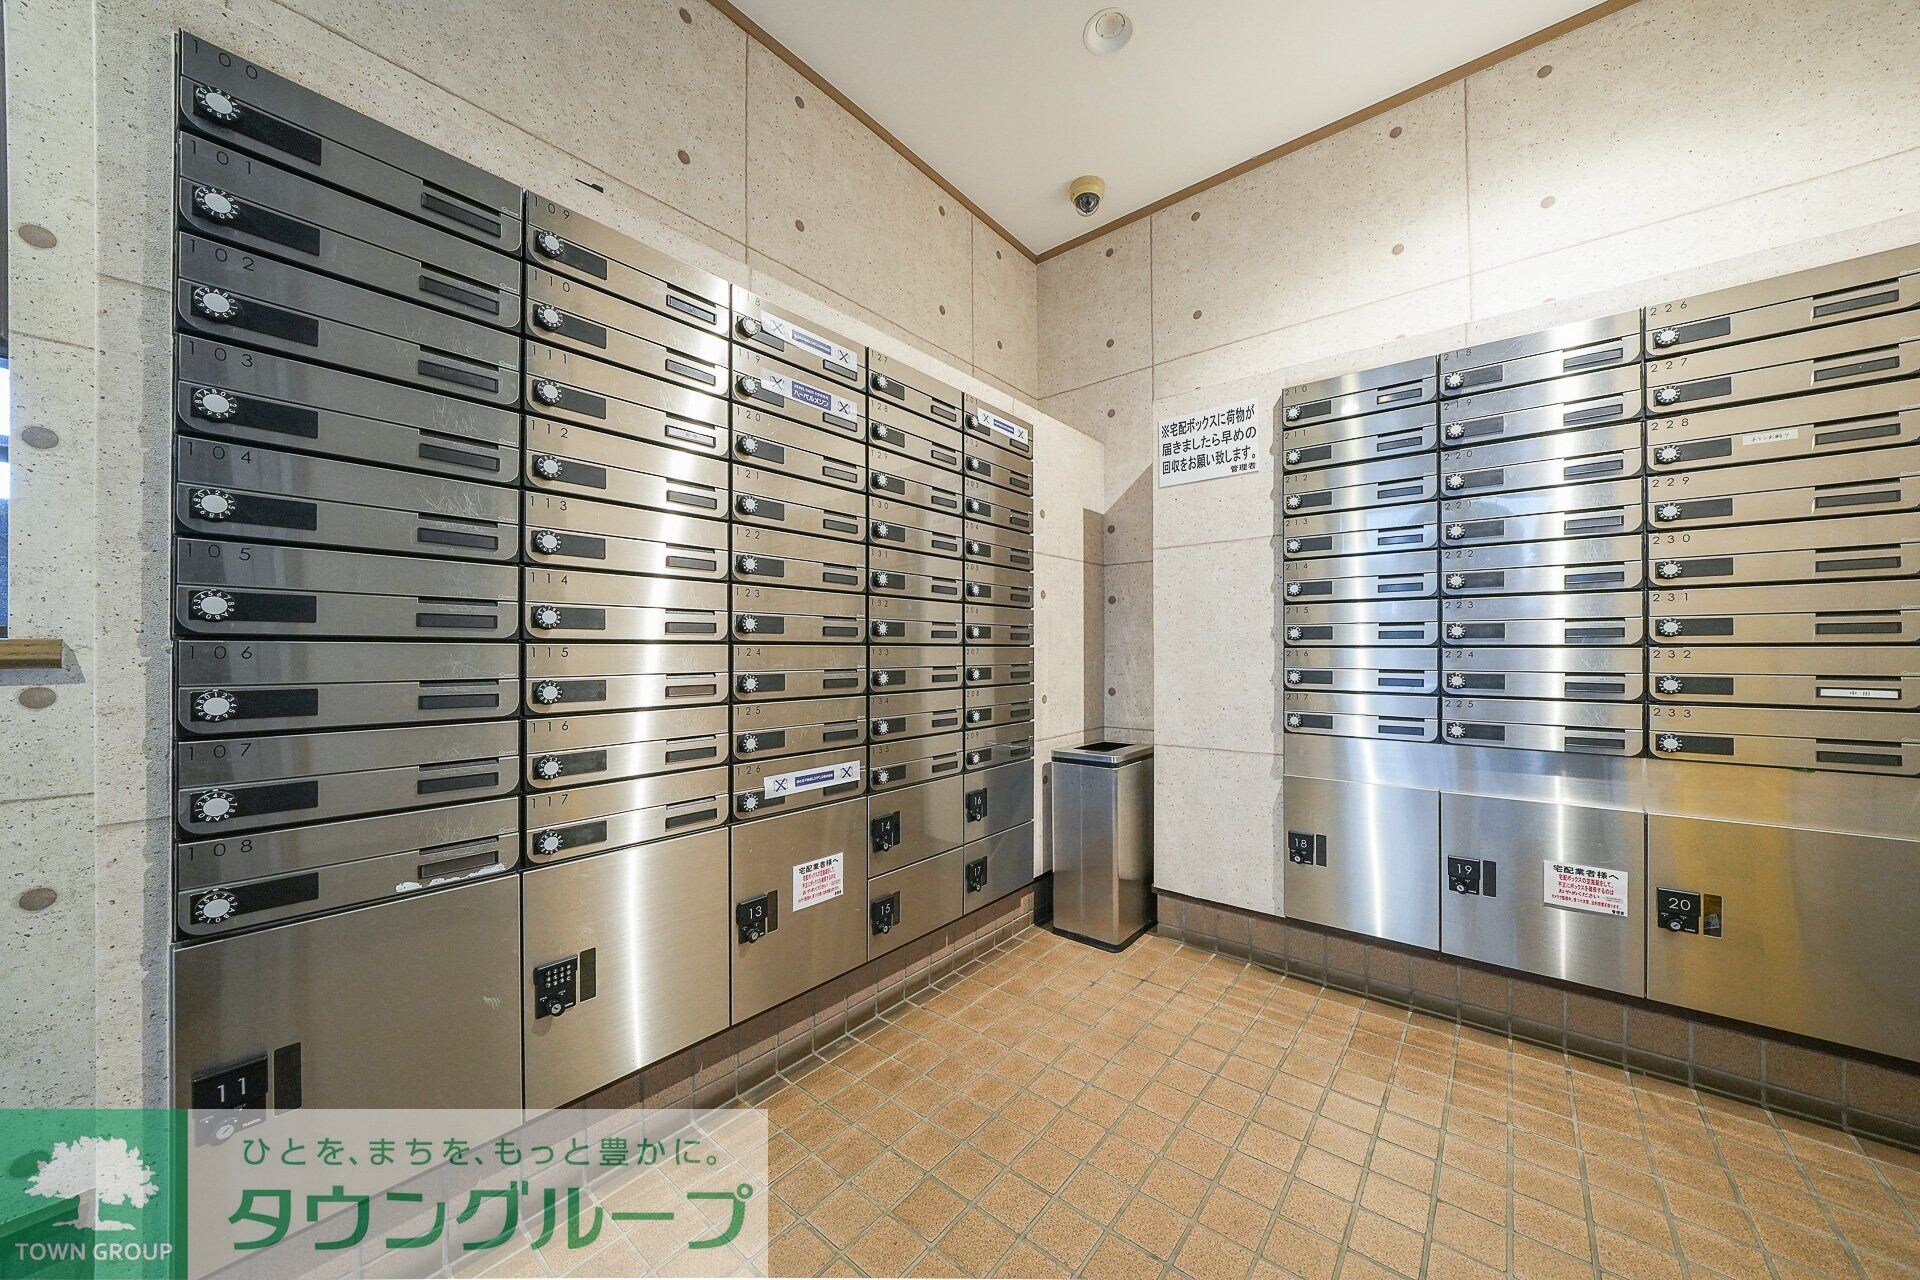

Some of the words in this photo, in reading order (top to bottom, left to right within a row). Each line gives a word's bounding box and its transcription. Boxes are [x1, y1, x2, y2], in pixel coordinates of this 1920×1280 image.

[192, 38, 258, 80] 100
[190, 139, 252, 176] 101
[533, 195, 570, 220] 109
[189, 238, 256, 272] 102
[533, 269, 571, 293] 110
[1650, 301, 1687, 316] 226
[189, 340, 254, 369] 103
[532, 345, 568, 365] 111
[738, 348, 760, 363] 119
[871, 350, 888, 363] 127
[1444, 349, 1472, 361] 218
[1650, 358, 1688, 373] 227
[1285, 386, 1308, 396] 210
[871, 399, 889, 413] 128
[1444, 399, 1472, 410] 219
[736, 407, 760, 422] 120
[531, 419, 568, 439] 112
[1651, 418, 1689, 431] 228
[1285, 429, 1306, 440] 211
[965, 435, 979, 448] 202
[1162, 426, 1257, 457] 届きましたら早めの
[186, 440, 253, 465] 104
[871, 449, 888, 461] 129
[1444, 450, 1473, 461] 220
[1162, 445, 1256, 475] 回収をお願い致します。
[736, 467, 759, 480] 121
[1231, 462, 1256, 473] 管理者
[1285, 475, 1308, 483] 212
[1652, 476, 1690, 488] 229
[530, 495, 568, 512] 113
[871, 499, 889, 510] 130
[1444, 500, 1472, 511] 221
[1285, 518, 1308, 527] 213
[736, 526, 760, 540] 122
[1653, 534, 1691, 545] 230
[185, 542, 252, 562] 105
[871, 548, 888, 559] 131
[1445, 550, 1474, 559] 222
[531, 571, 568, 585] 114
[735, 587, 760, 598] 123
[1653, 593, 1689, 602] 231
[871, 598, 889, 608] 132
[1445, 601, 1474, 609] 223
[188, 645, 253, 660] 106
[531, 646, 569, 658] 115
[737, 648, 761, 657] 124
[872, 648, 889, 656] 133
[966, 648, 979, 656] 207
[1653, 649, 1691, 659] 232
[966, 690, 980, 698] 208
[1286, 693, 1308, 701] 217
[872, 696, 889, 705] 134
[1446, 700, 1474, 708] 225
[736, 705, 761, 716] 125
[1653, 708, 1691, 718] 233
[532, 719, 569, 733] 116
[187, 742, 252, 761] 107
[872, 746, 890, 756] 135
[736, 764, 761, 776] 126
[531, 793, 569, 809] 117
[974, 796, 982, 805] 16
[881, 821, 891, 832] 14
[1295, 838, 1307, 848] 18
[188, 839, 253, 862] 108
[974, 867, 981, 876] 17
[1457, 863, 1473, 874] 19
[1553, 864, 1619, 880] 宅配業者様へ
[881, 904, 891, 916] 15
[1669, 897, 1691, 911] 20
[749, 906, 762, 919] 13
[217, 1077, 246, 1103] 11
